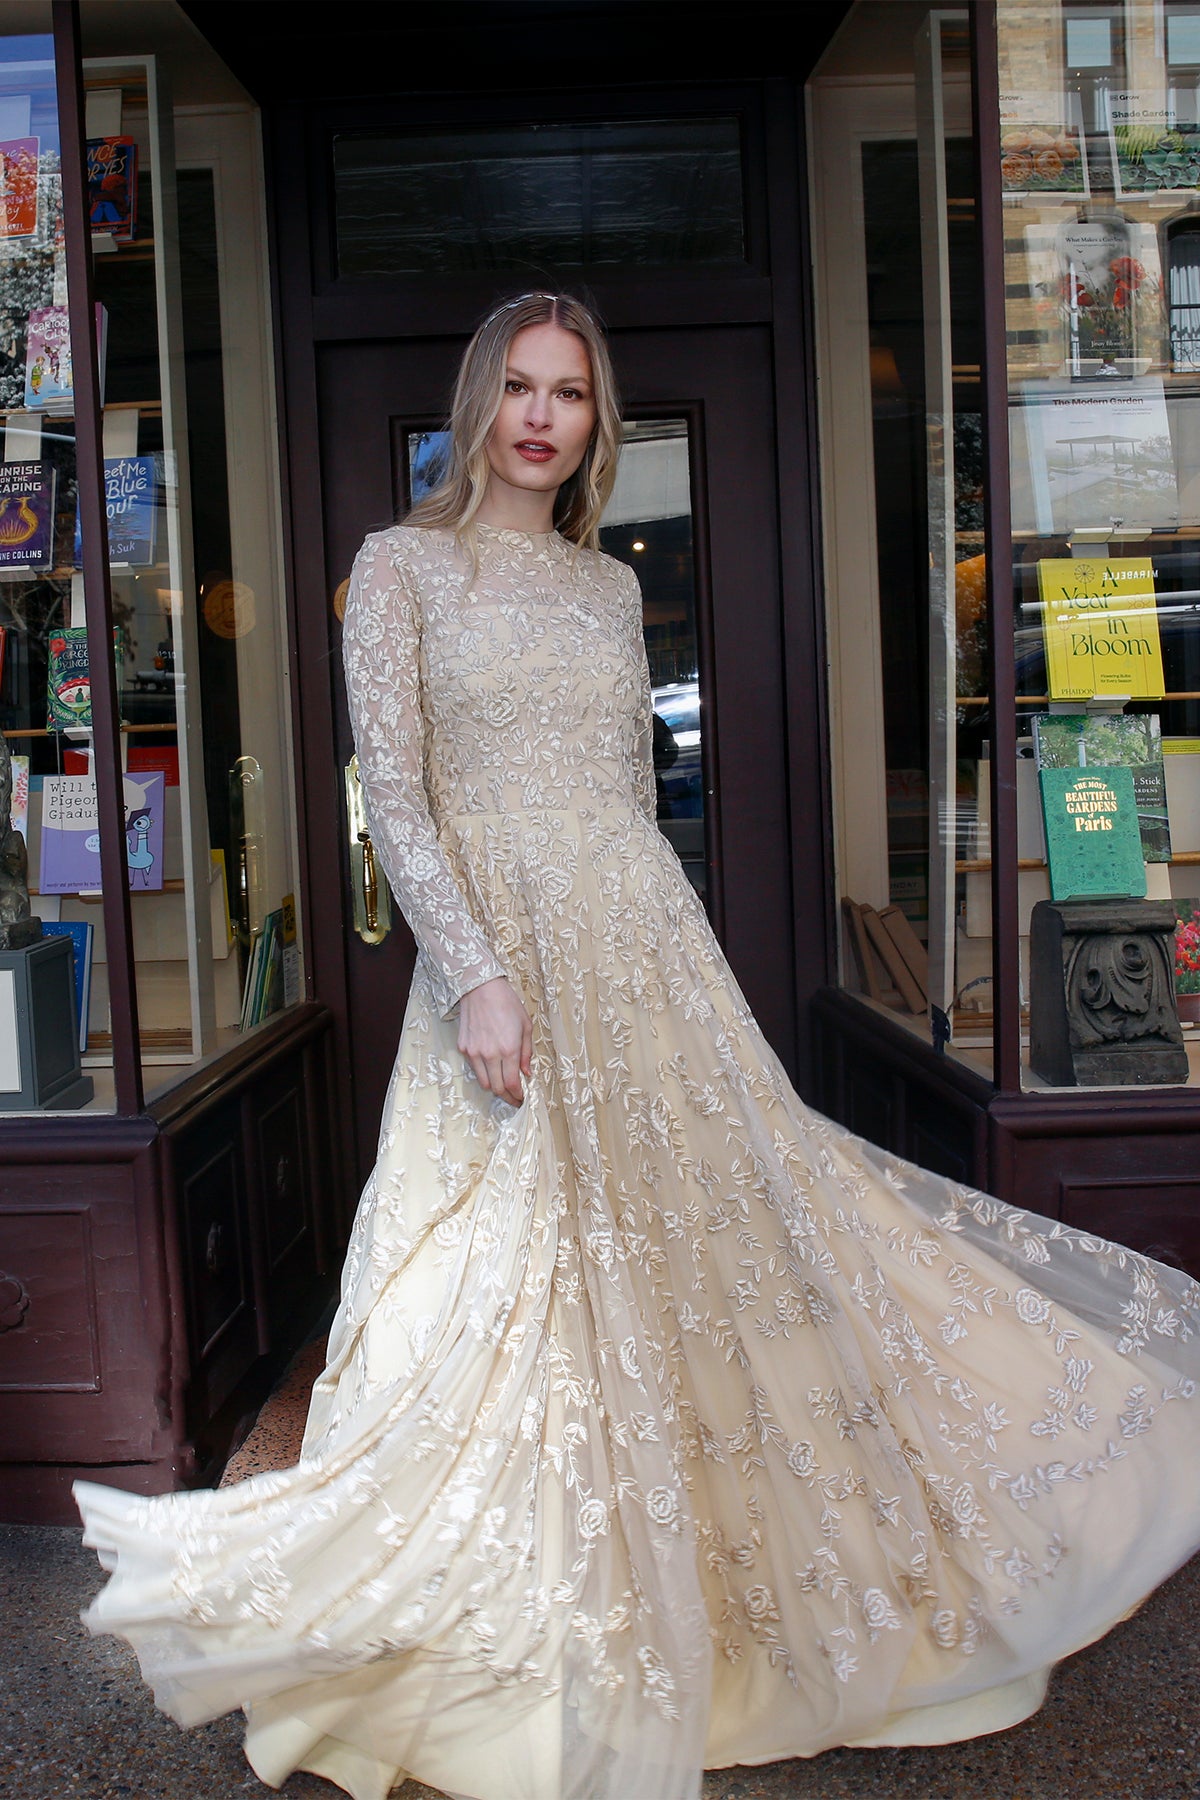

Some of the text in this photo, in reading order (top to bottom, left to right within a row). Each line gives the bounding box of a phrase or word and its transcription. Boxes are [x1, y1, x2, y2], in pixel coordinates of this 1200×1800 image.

[1111, 109, 1176, 118] Shade Garden
[102, 154, 128, 179] YES
[1072, 398, 1108, 406] Modern
[1110, 397, 1144, 405] Garden
[126, 462, 147, 479] Me
[0, 482, 42, 494] APING
[106, 476, 148, 499] Blue
[117, 541, 136, 554] Suk
[12, 550, 42, 559] COLLINS
[1101, 566, 1118, 588] A
[1061, 587, 1113, 609] Year
[1107, 615, 1129, 635] in
[1071, 634, 1153, 657] Bloom
[1061, 688, 1095, 696] PHAIDON
[50, 782, 83, 793] Will
[1073, 781, 1108, 791] THE MOST
[1139, 776, 1161, 786] Stick
[1065, 791, 1118, 803] BEAUTIFUL
[1066, 801, 1119, 814] GARDENS
[1075, 815, 1114, 833] Paris
